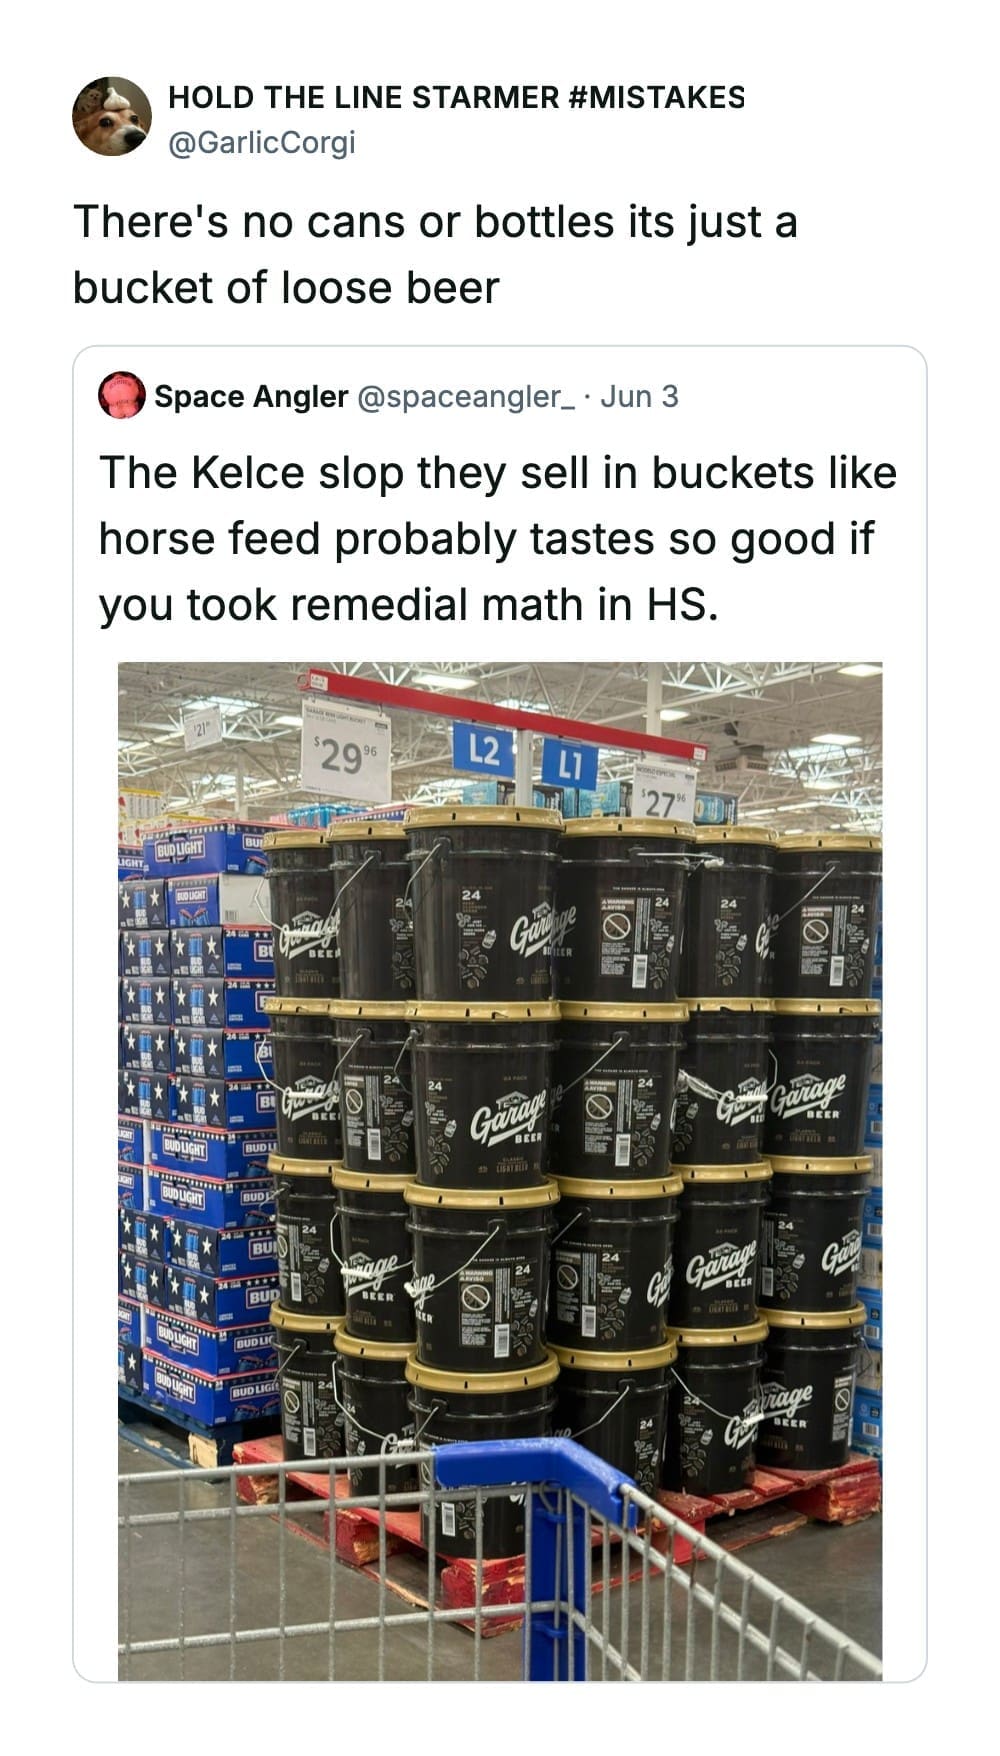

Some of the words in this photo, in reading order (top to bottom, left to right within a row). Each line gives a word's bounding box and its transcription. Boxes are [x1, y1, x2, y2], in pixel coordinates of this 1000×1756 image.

[470, 733, 500, 766] L2
[559, 750, 583, 780] L1
[245, 837, 263, 848] BU
[157, 843, 176, 857] BUD
[177, 840, 204, 855] LIGHT
[176, 891, 189, 901] BUD
[189, 890, 206, 901] LIGHT
[462, 890, 482, 901] 24
[655, 897, 669, 908] 24
[720, 899, 737, 909] 24
[851, 904, 865, 913] 24
[383, 1075, 400, 1085] 24
[638, 1078, 654, 1088] 24
[428, 1081, 443, 1091] 24
[770, 1074, 847, 1117] Garage
[312, 1112, 341, 1121] BEE
[470, 1089, 547, 1145] Garage
[807, 1110, 840, 1119] BEER
[515, 1132, 543, 1145] BEER
[164, 1138, 181, 1152] BUD
[181, 1141, 206, 1157] LIGHT
[245, 1143, 267, 1153] BUD
[162, 1184, 179, 1199] BUD
[179, 1188, 204, 1206] LIGHT
[243, 1191, 265, 1202] BUD
[302, 1225, 317, 1234] 24
[778, 1221, 794, 1230] 24
[602, 1253, 620, 1262] 24
[515, 1264, 531, 1275] 24
[686, 1240, 757, 1288] Garage
[725, 1278, 753, 1288] BEER
[362, 1290, 394, 1302] BEER
[158, 1326, 175, 1342] BUD
[175, 1331, 197, 1351] LIGHT
[236, 1338, 259, 1349] BUD
[156, 1373, 171, 1388] BUD
[171, 1378, 194, 1400] LIGHT
[318, 1381, 334, 1389] 24
[232, 1386, 256, 1397] BUD
[640, 1419, 653, 1429] 24
[774, 1417, 807, 1429] BEER
